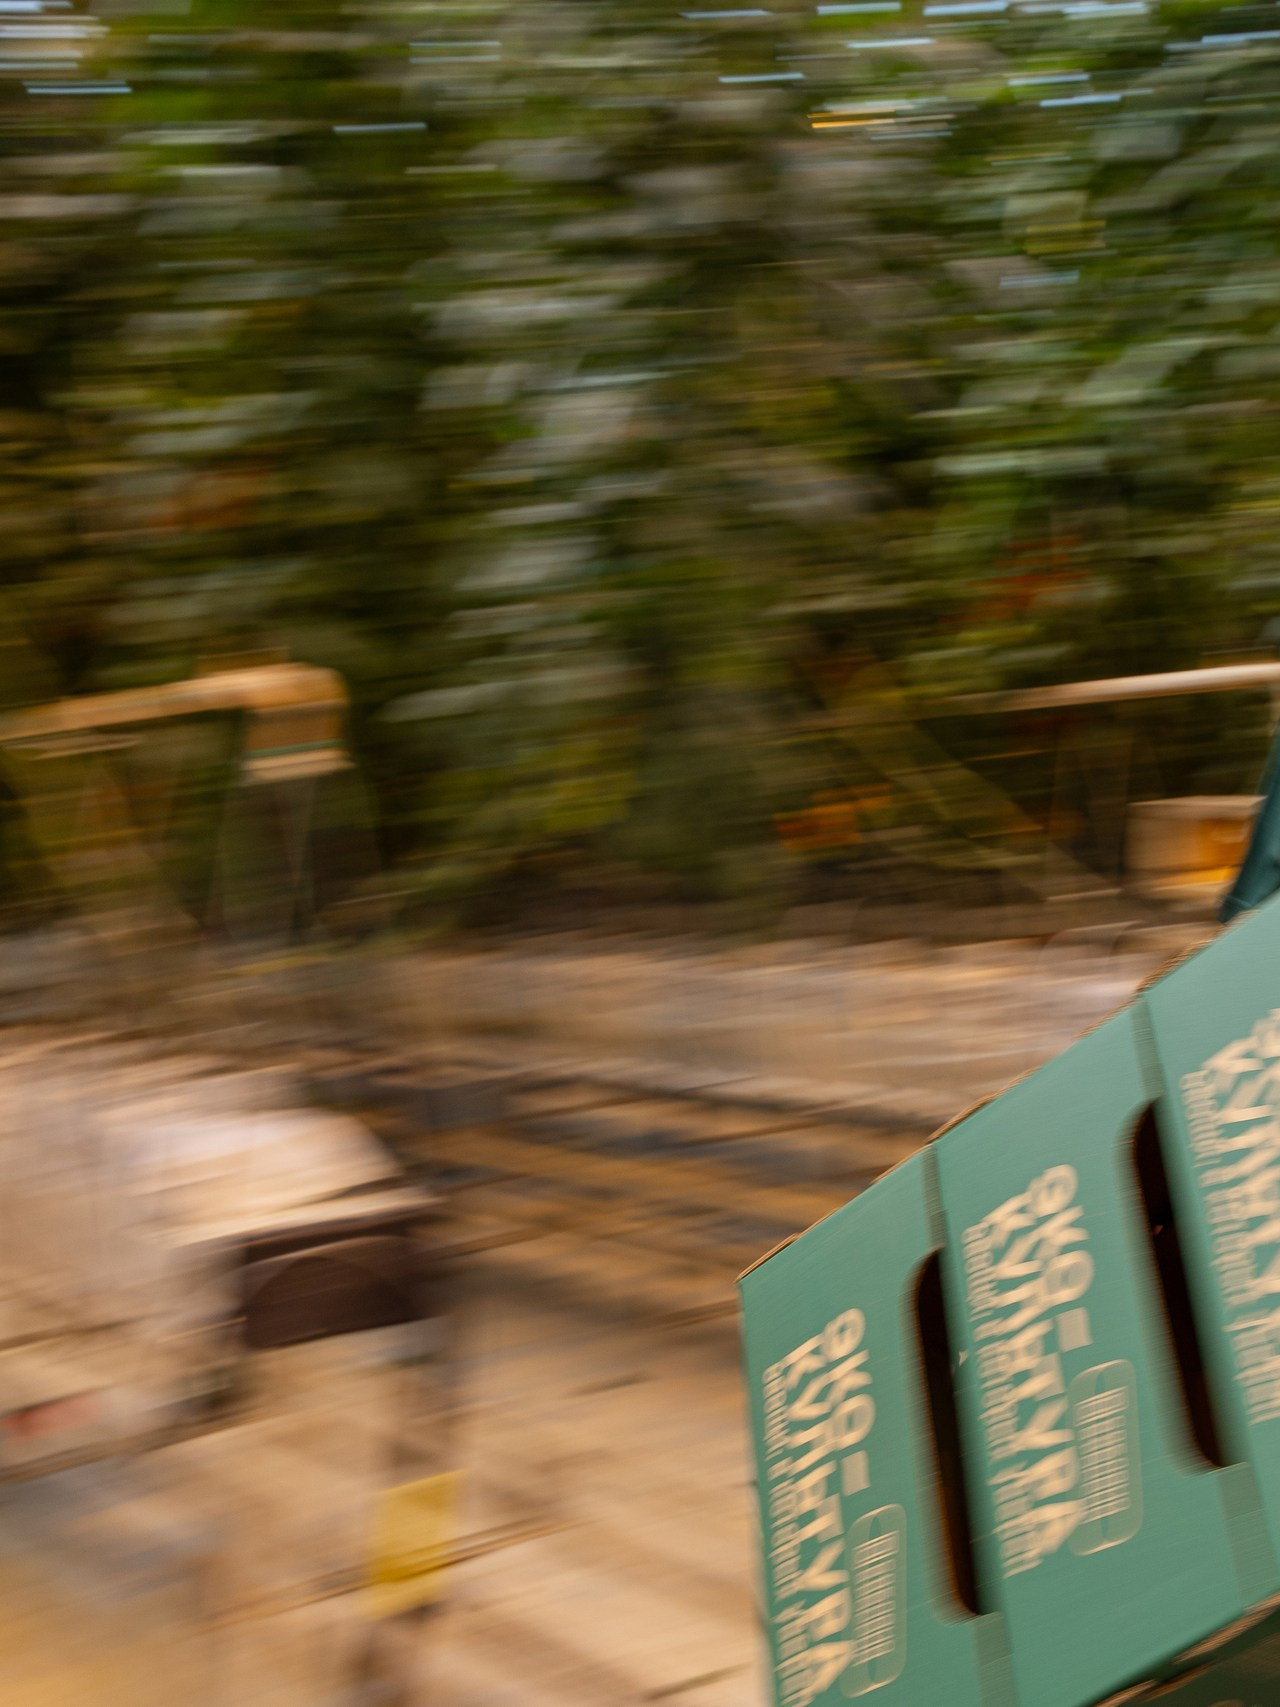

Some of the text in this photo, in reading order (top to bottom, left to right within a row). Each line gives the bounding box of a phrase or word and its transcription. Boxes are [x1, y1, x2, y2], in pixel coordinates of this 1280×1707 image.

[981, 1192, 1086, 1556] КУЛЬТУРА
[1025, 1164, 1092, 1352] ЭКО-
[783, 1333, 854, 1696] КУЛЬТУРА
[821, 1308, 876, 1496] ЭКО-
